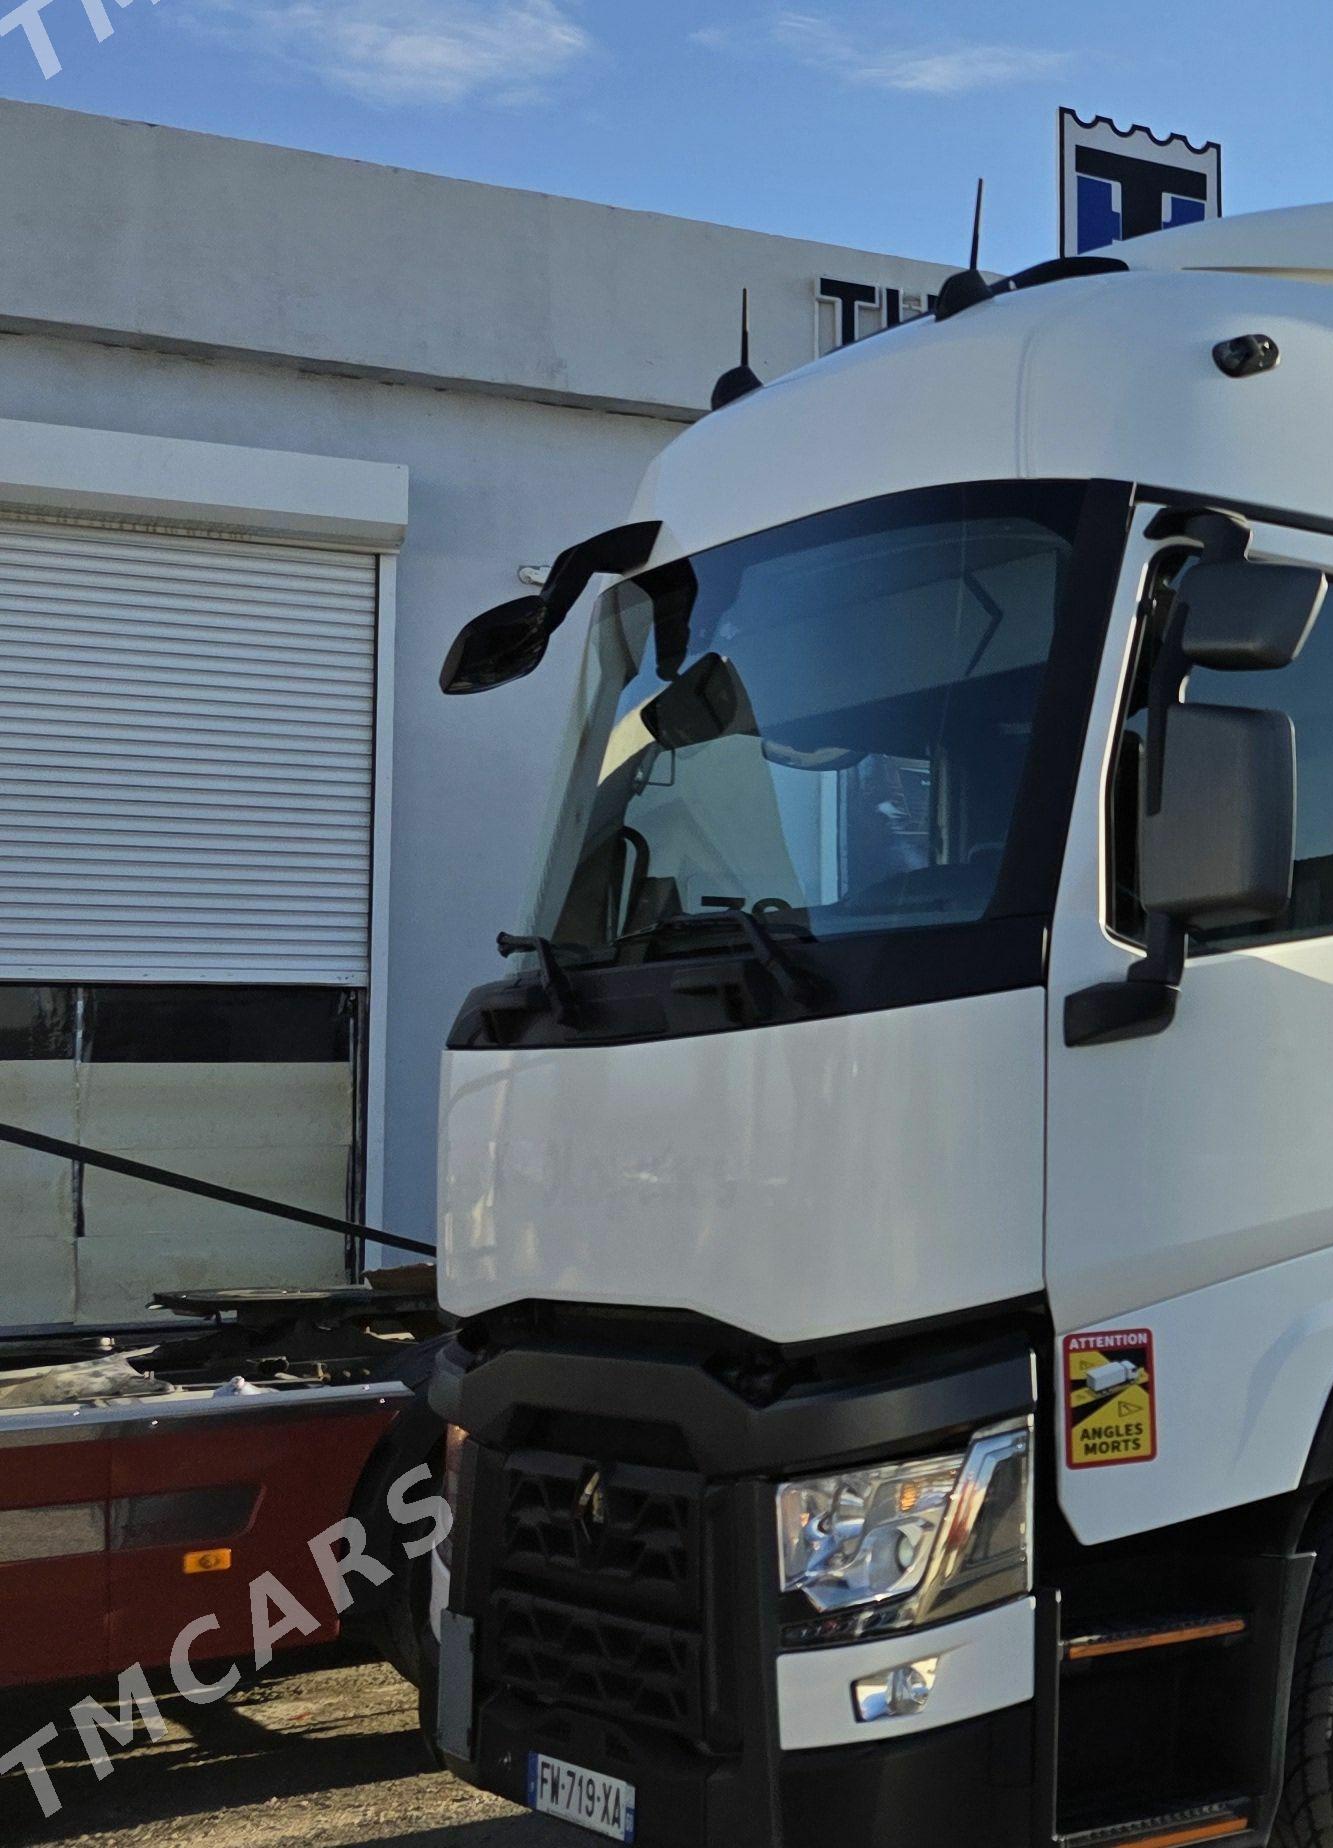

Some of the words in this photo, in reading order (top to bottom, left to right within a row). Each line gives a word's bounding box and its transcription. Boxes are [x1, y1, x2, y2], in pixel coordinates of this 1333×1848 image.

[1069, 1333, 1148, 1350] ATTENTION
[1080, 1423, 1143, 1441] ANGLES
[1084, 1438, 1142, 1456] MORTS
